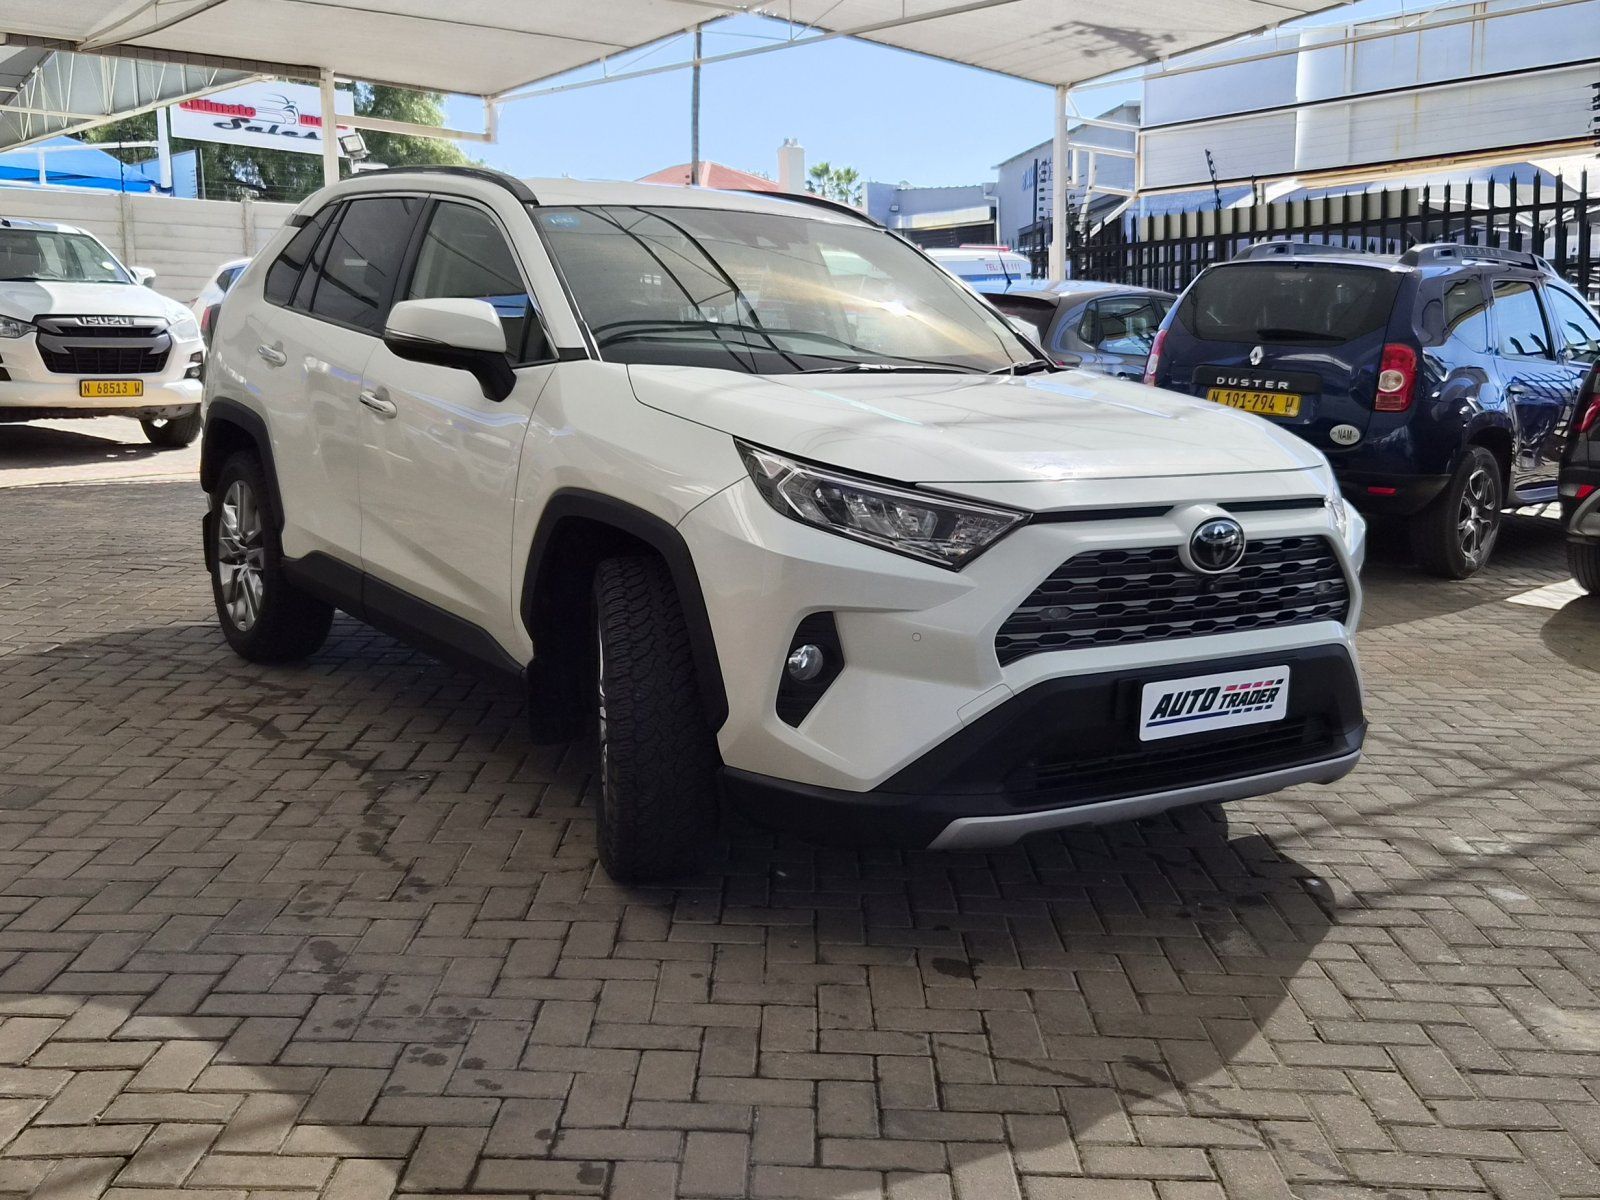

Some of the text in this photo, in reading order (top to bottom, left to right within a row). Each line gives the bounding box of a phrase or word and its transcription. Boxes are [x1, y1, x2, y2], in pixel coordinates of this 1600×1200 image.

[213, 117, 319, 140] Sales
[81, 316, 131, 326] ISUZU
[83, 382, 141, 394] N 68513 W
[1216, 376, 1289, 390] DUSTER
[1211, 391, 1220, 402] N
[1225, 391, 1275, 412] 191-794
[1337, 429, 1353, 441] NAM
[1148, 686, 1280, 720] AUTO TRADER
